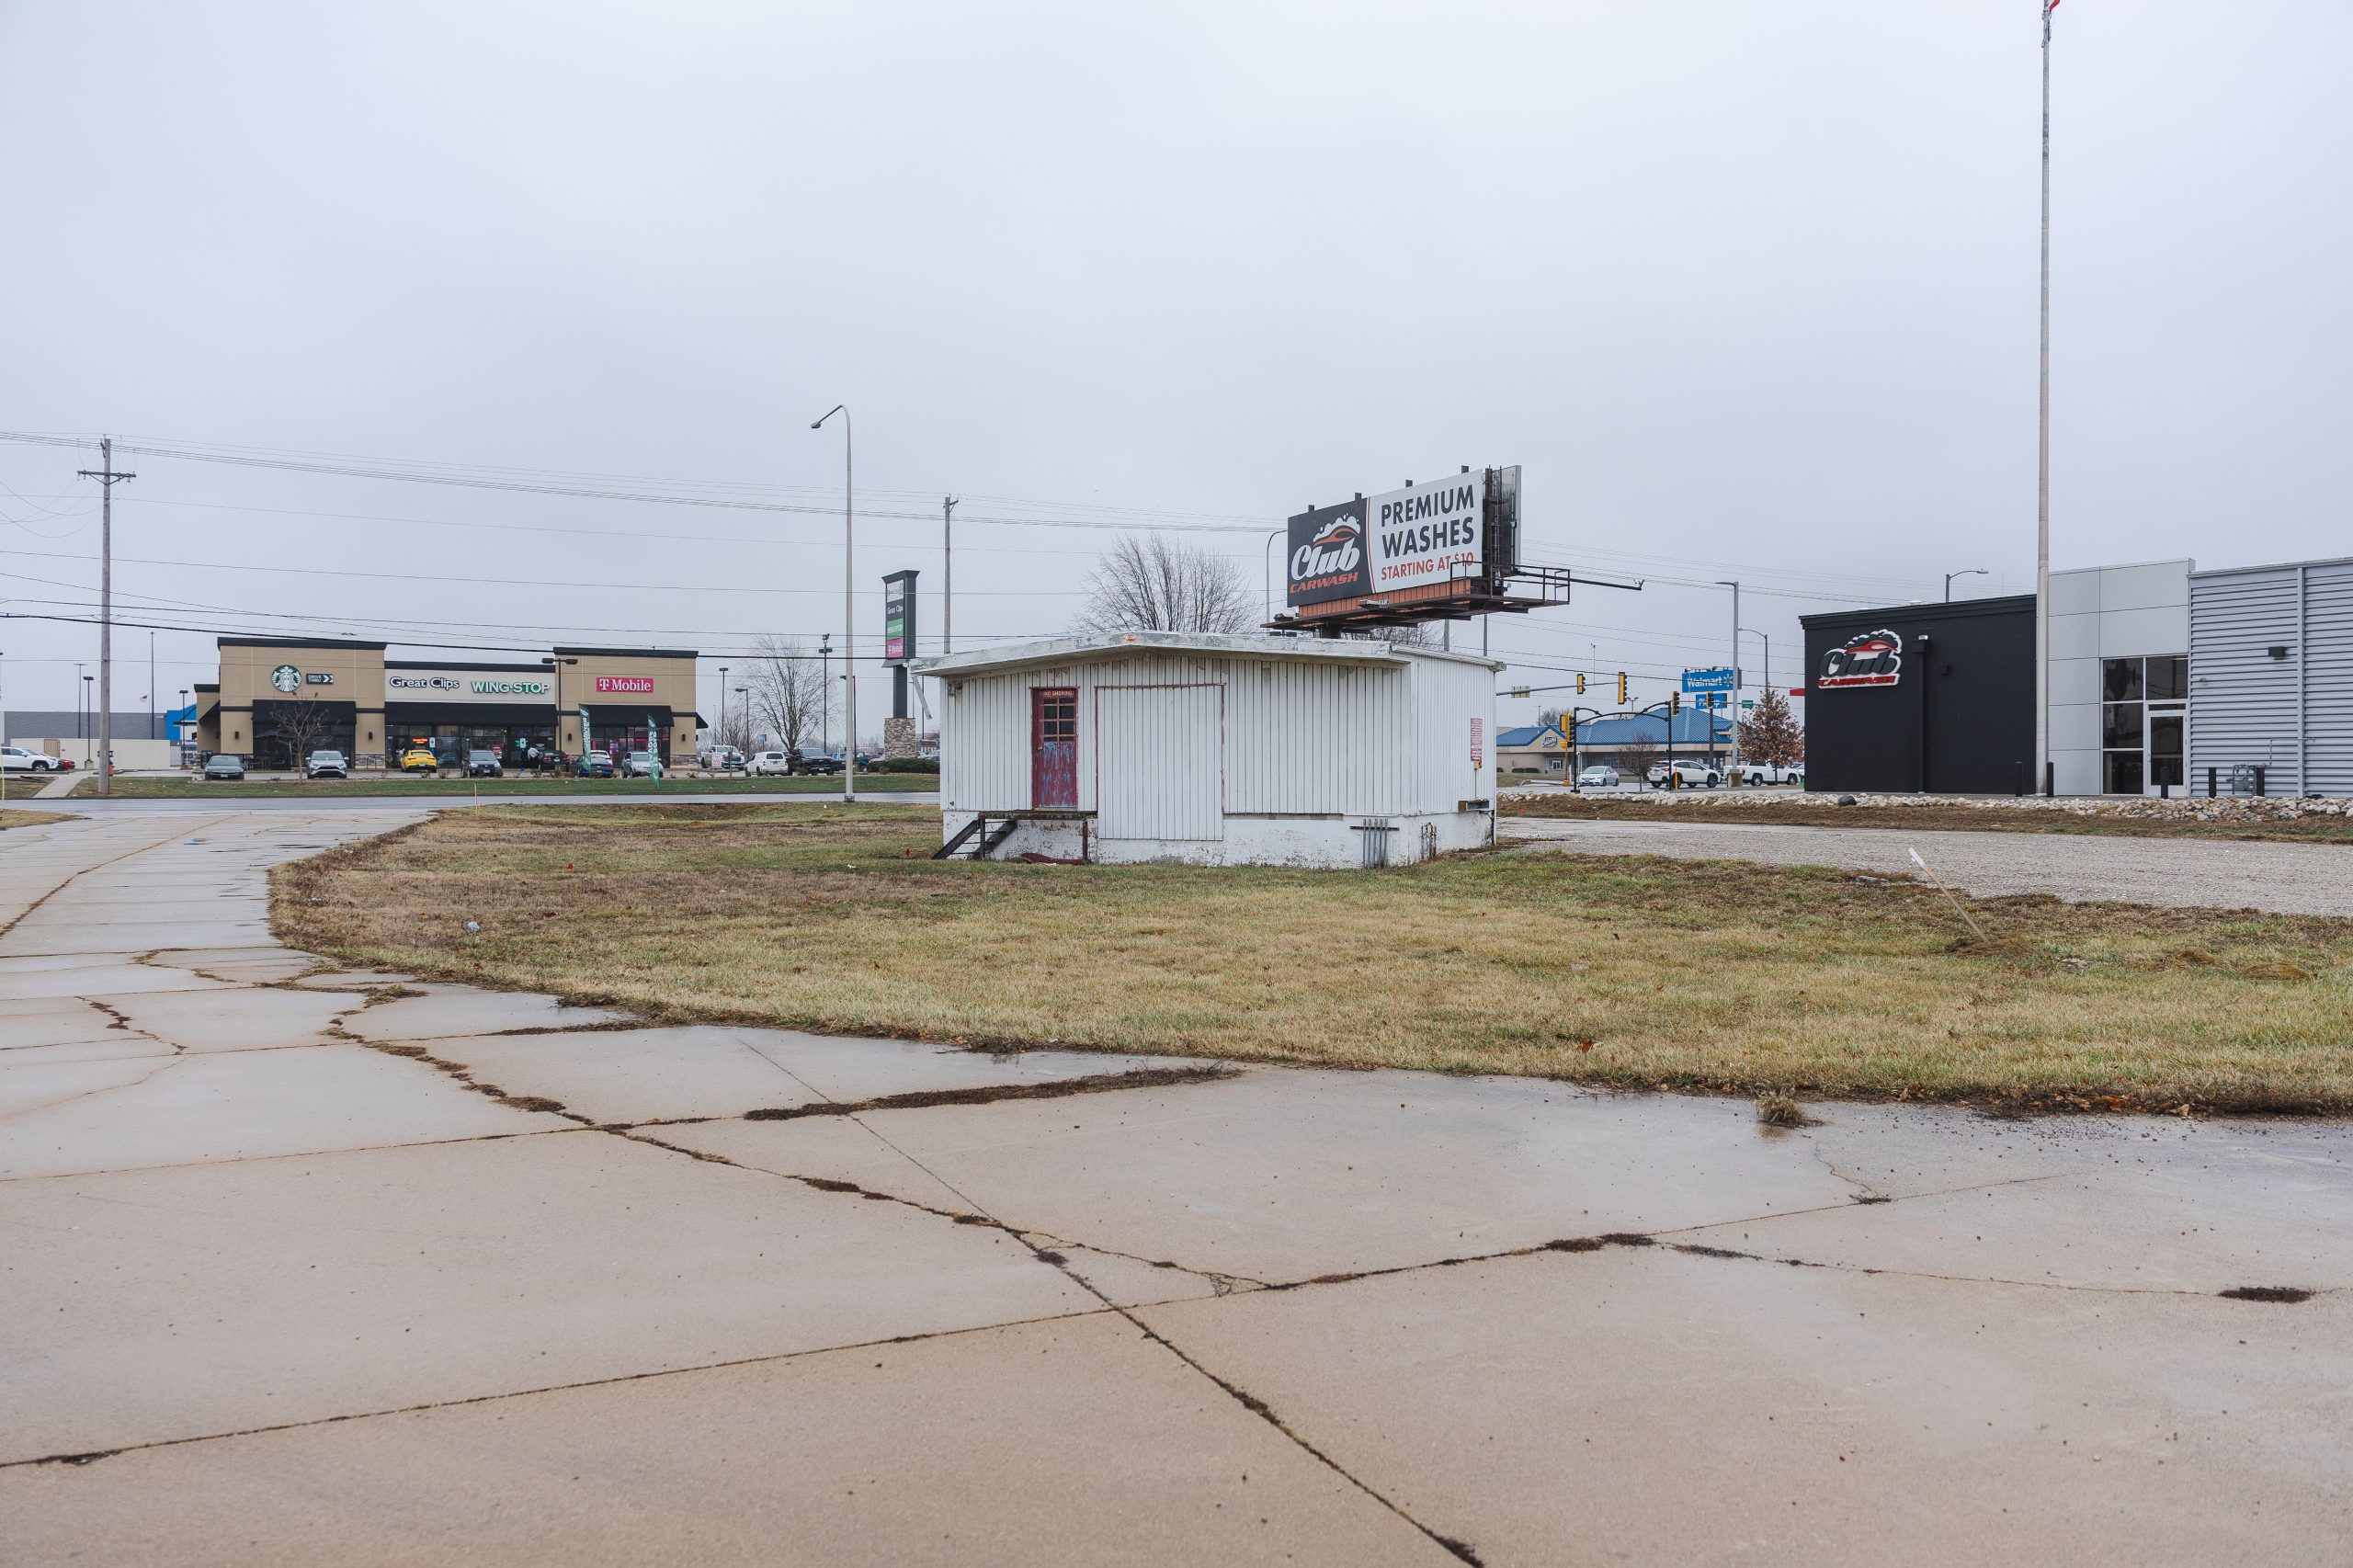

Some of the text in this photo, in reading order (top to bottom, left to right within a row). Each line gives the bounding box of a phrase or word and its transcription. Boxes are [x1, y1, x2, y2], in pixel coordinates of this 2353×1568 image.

[1381, 484, 1474, 527] PREMIUM
[1381, 517, 1474, 559] WASHES
[1291, 537, 1360, 580] Club
[1381, 551, 1474, 581] STARTING AT $10
[1290, 572, 1358, 594] CARWASH
[1820, 649, 1899, 677] Club
[390, 676, 460, 690] Great Clips
[1687, 676, 1722, 687] Walmart
